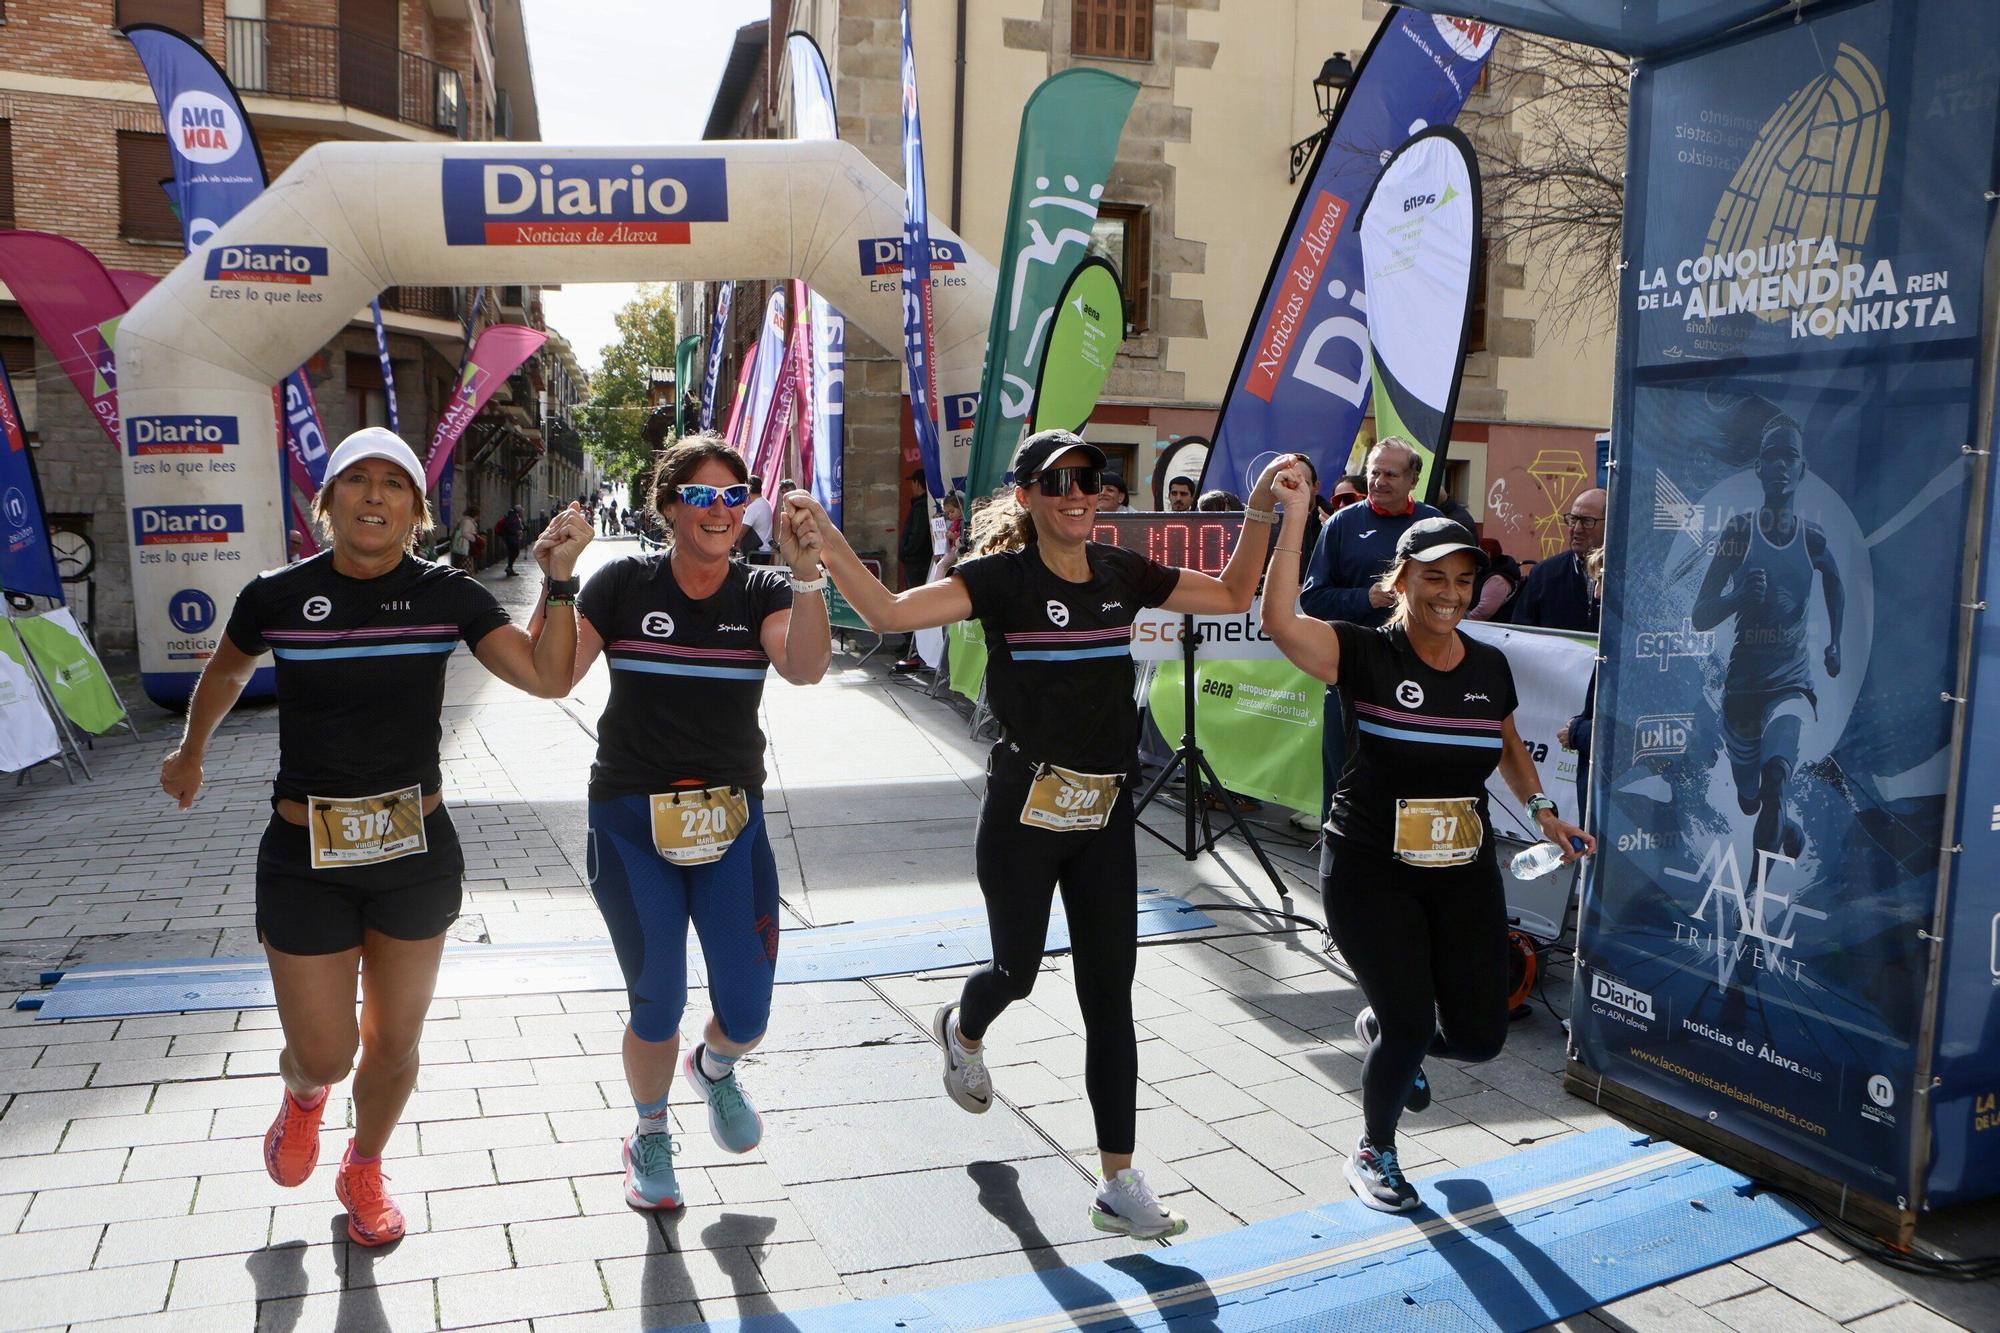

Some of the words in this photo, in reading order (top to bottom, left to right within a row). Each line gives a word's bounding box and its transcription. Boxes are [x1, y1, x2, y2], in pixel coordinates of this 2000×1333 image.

[483, 163, 688, 215] Diario
[515, 227, 582, 244] Noticias
[586, 228, 604, 243] de
[608, 222, 658, 243] Álava
[1304, 199, 1342, 266] Álava
[221, 247, 311, 273] Diario
[1639, 268, 1667, 291] LA
[1676, 234, 1839, 286] CONQUISTA
[870, 280, 896, 293] Eres
[944, 275, 967, 287] lees
[1297, 265, 1315, 292] de
[1637, 294, 1659, 311] DE
[1663, 291, 1682, 307] LA
[1683, 259, 1897, 321] ALMENDRA
[1907, 271, 1948, 294] REN
[209, 285, 241, 300] Eres
[245, 287, 259, 301] lo
[264, 291, 292, 304] que
[296, 290, 323, 303] lees
[1083, 304, 1100, 321] aena
[1791, 295, 1956, 339] KONKISTA
[1257, 293, 1305, 380] Noticias
[135, 418, 223, 443] Diario
[953, 434, 973, 448] Ere
[133, 460, 156, 475] Eres
[160, 459, 171, 473] lo
[176, 462, 203, 476] que
[209, 458, 237, 473] lees
[141, 508, 228, 533] Diario
[140, 550, 161, 564] Eres
[165, 549, 177, 563] lo
[181, 551, 209, 566] que
[214, 548, 241, 561] lees
[181, 601, 203, 622] n
[166, 637, 218, 651] noticia
[1202, 678, 1234, 699] aena
[1054, 785, 1101, 811] 320
[341, 810, 393, 842] 378
[680, 806, 727, 838] 220
[1431, 816, 1459, 843] 87
[1673, 921, 1807, 982] TRIEVENT
[1597, 978, 1649, 1014] Diario
[1591, 1003, 1606, 1016] Con
[1607, 1010, 1625, 1023] ADN
[1682, 1018, 1734, 1047] noticias
[1736, 1038, 1755, 1055] de
[1630, 1046, 1827, 1137] www.laconquistadelaalmendra.com
[1976, 1093, 1996, 1113] LA
